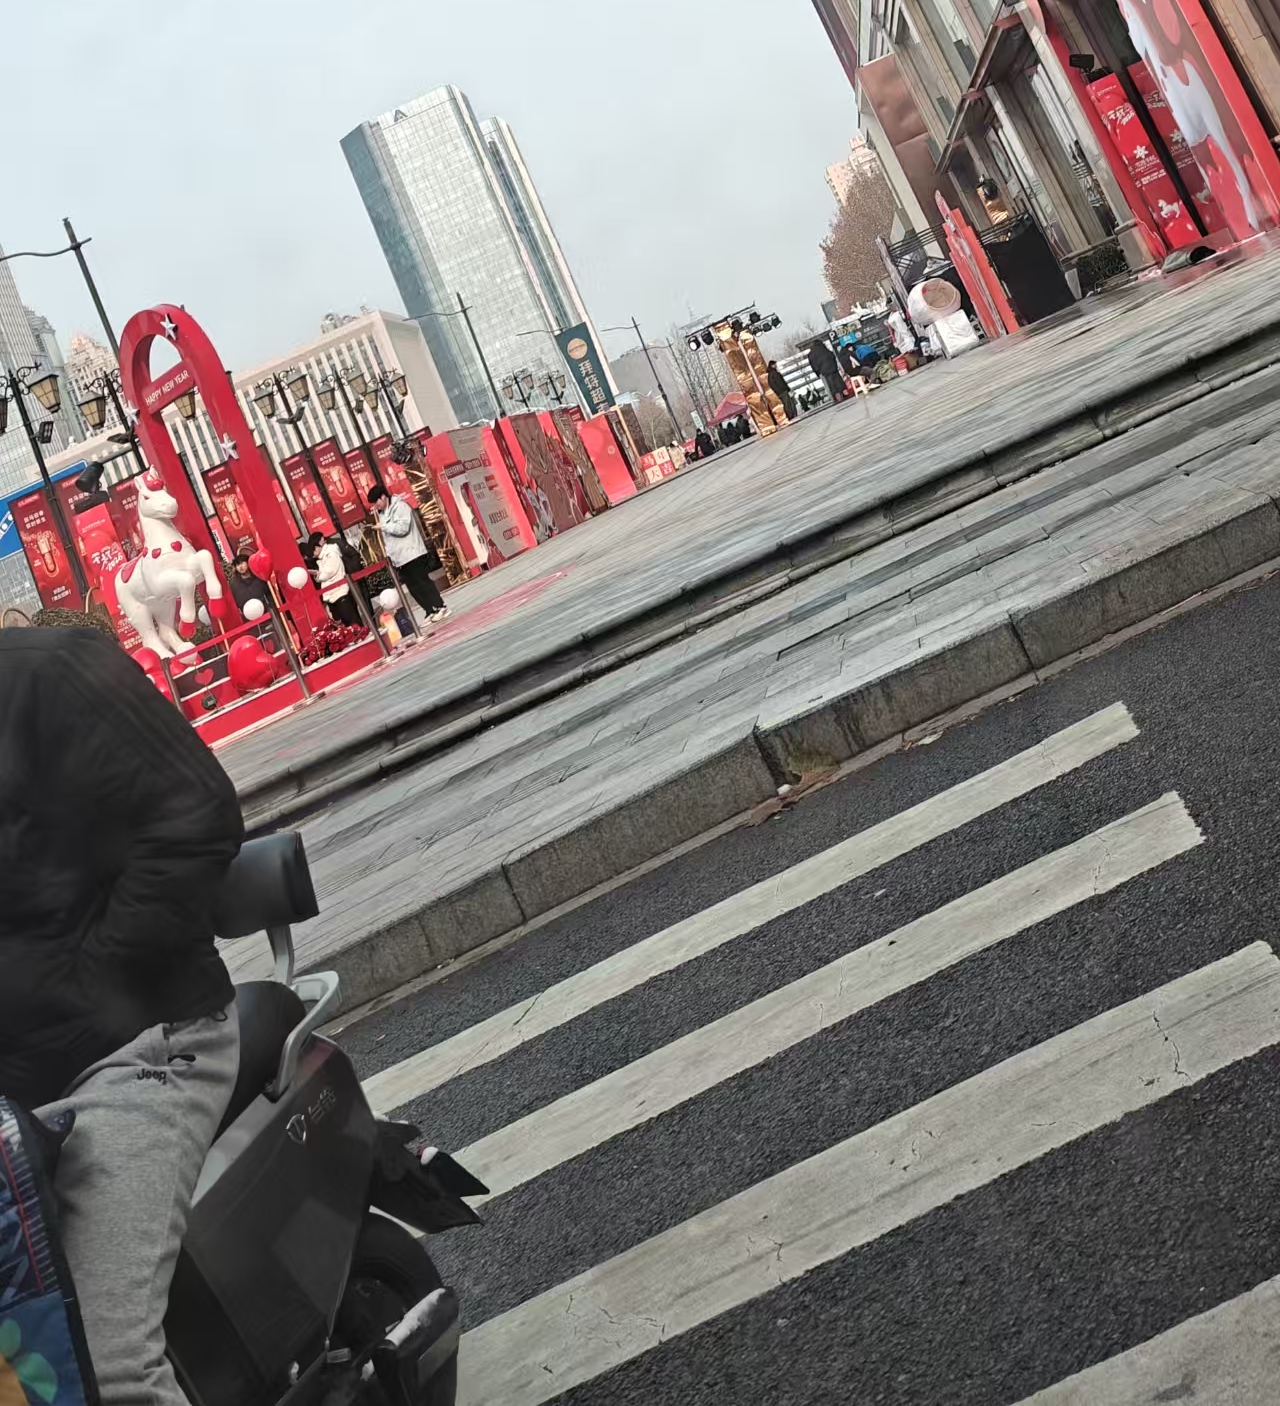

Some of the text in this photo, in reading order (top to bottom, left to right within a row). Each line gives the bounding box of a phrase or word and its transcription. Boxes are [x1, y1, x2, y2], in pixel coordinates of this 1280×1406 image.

[145, 370, 189, 406] HAPPY NEW YEAR
[137, 1068, 167, 1082] Jeep
